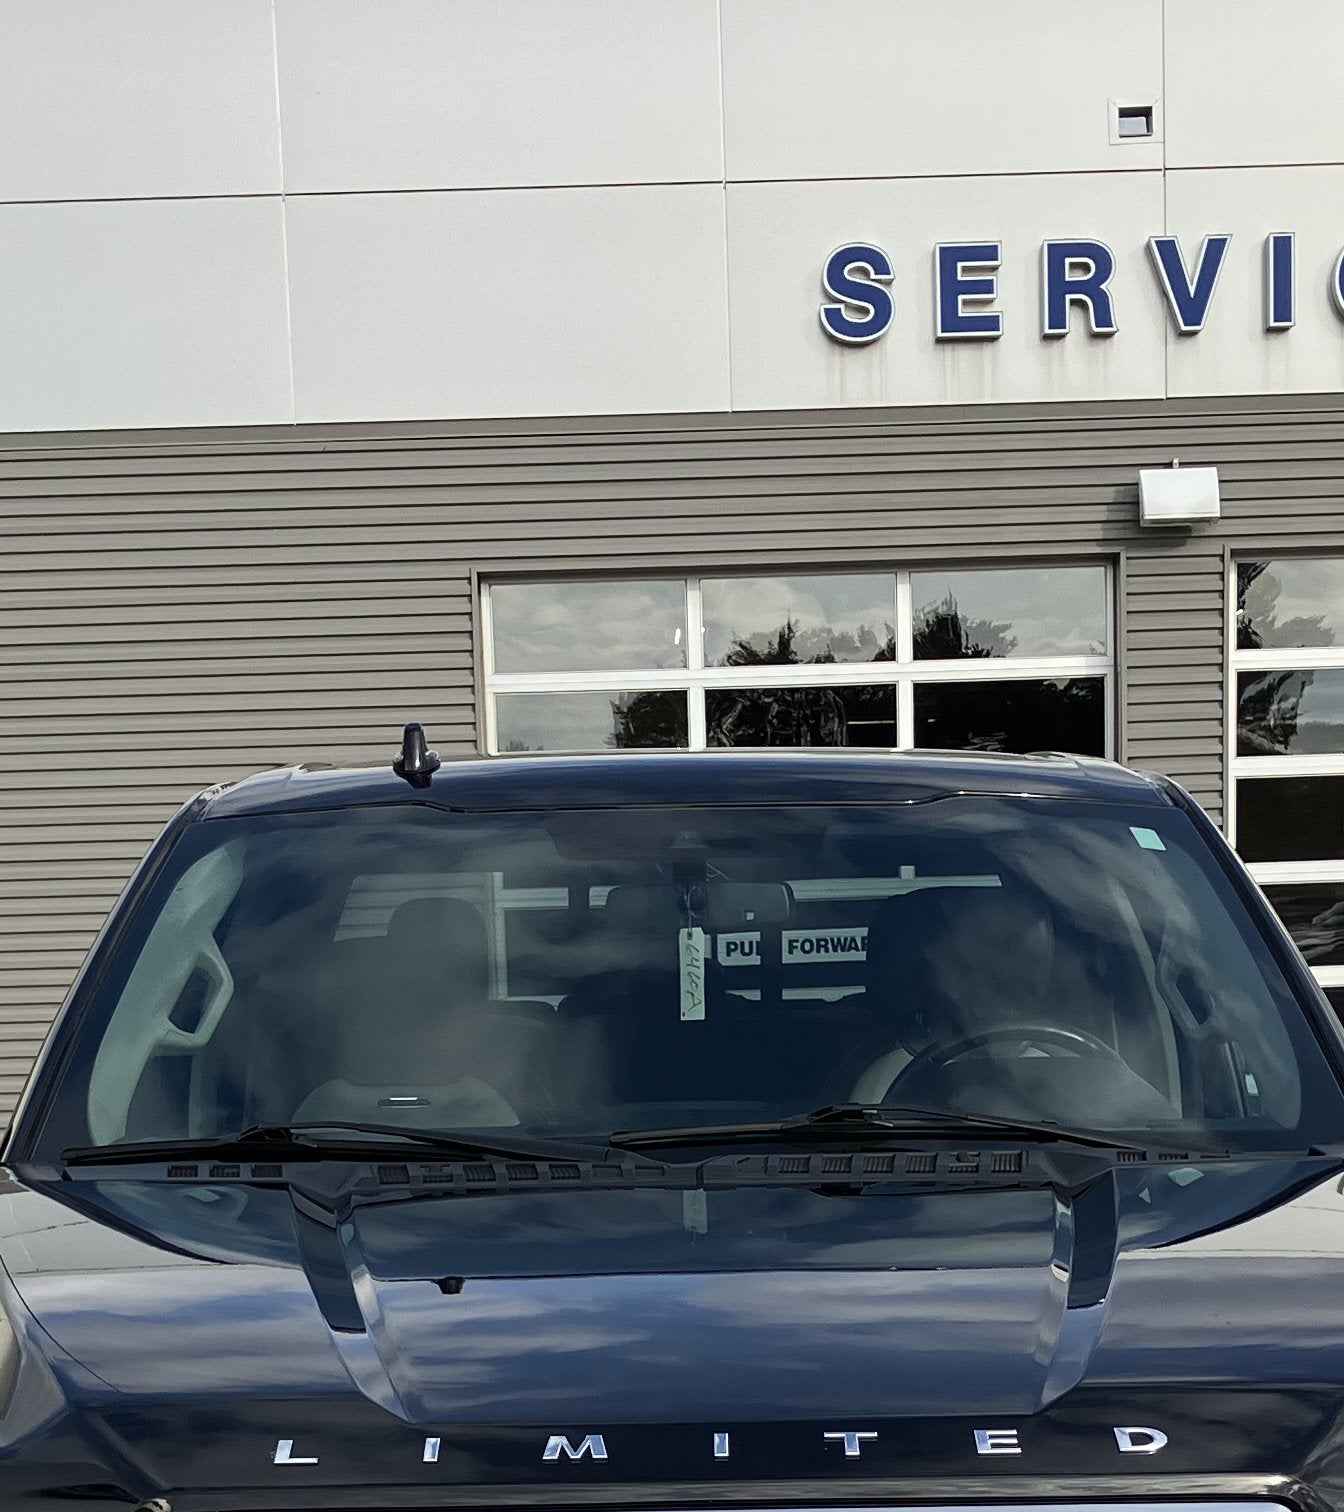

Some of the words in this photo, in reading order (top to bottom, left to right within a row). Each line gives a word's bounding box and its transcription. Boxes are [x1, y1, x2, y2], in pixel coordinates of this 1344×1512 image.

[725, 940, 761, 957] PU
[787, 935, 868, 955] FORWA
[272, 1425, 1169, 1465] LIMITED
